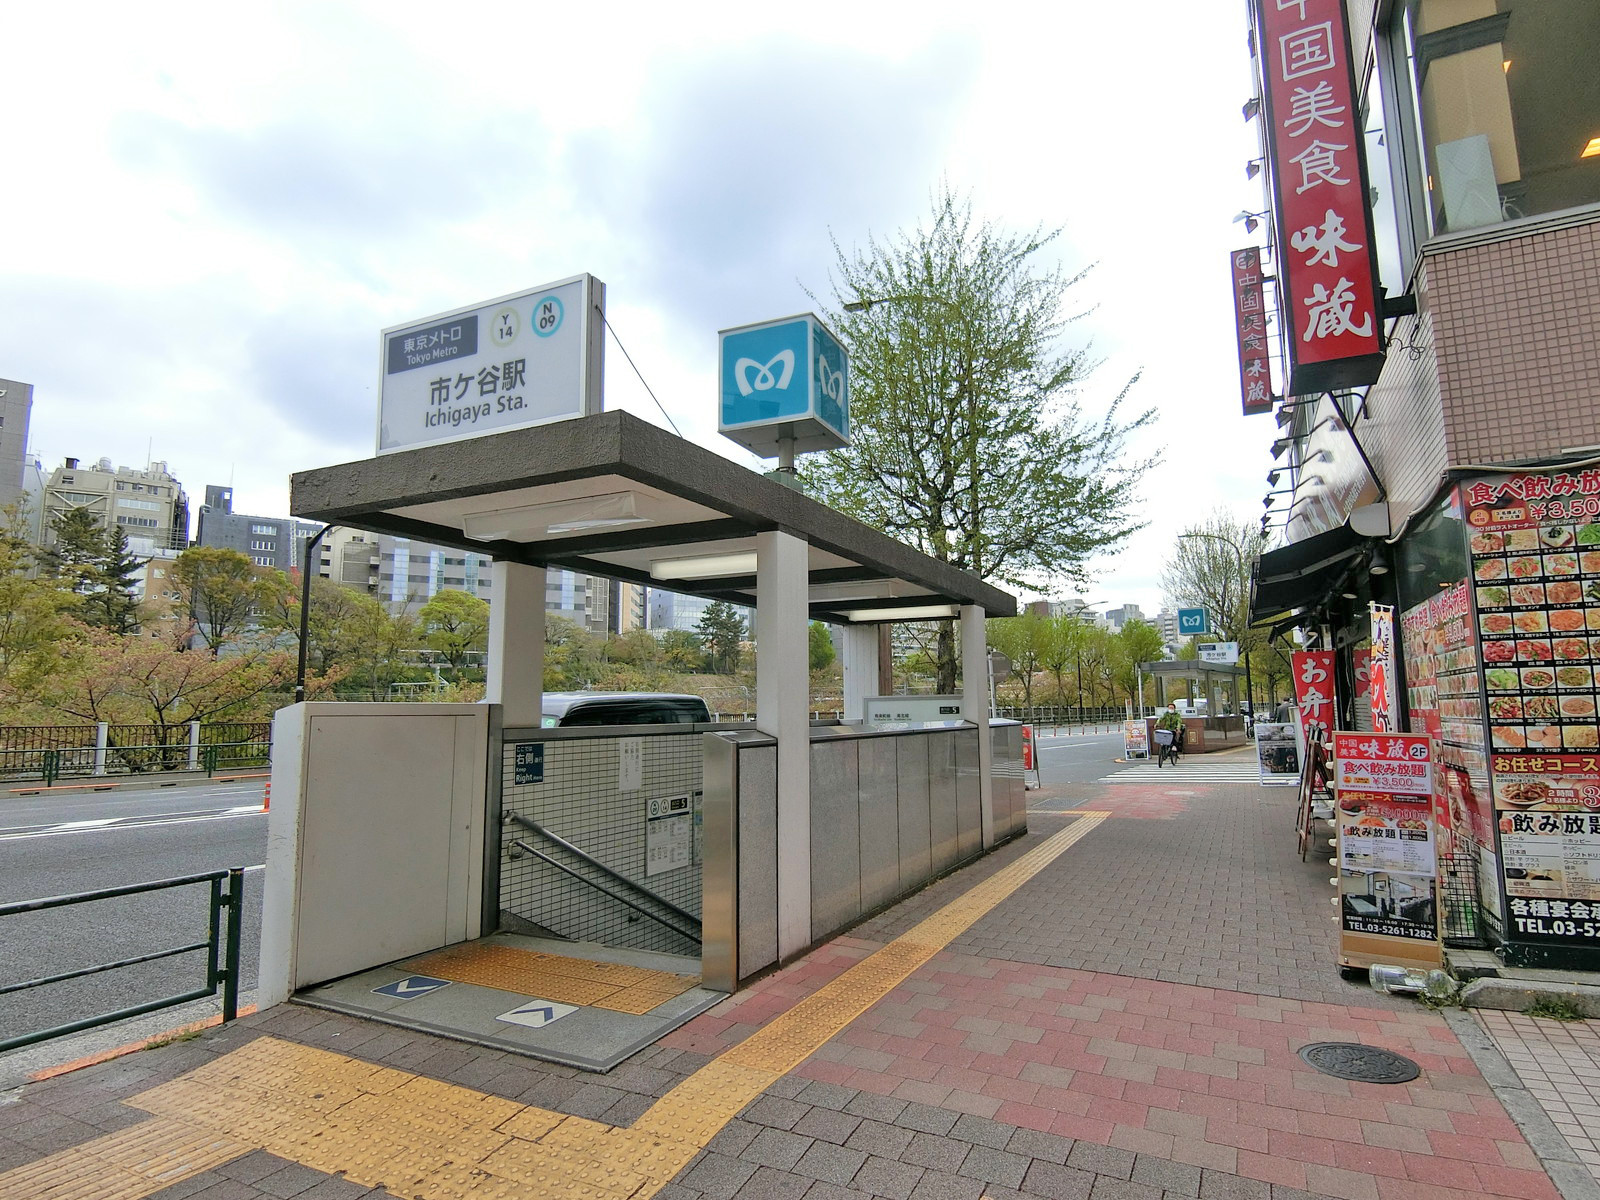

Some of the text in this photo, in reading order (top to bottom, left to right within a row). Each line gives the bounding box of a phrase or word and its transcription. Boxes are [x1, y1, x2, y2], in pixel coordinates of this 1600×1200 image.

[1290, 208, 1372, 343] 味蔵
[542, 302, 553, 315] N
[501, 314, 509, 325] Y
[539, 314, 556, 330] 09
[403, 325, 461, 354] 東京メトロ
[499, 326, 513, 340] 14
[406, 345, 458, 366] Tokyo Metro
[425, 395, 528, 428] Ichigaya Sta.
[1410, 746, 1426, 757] 2F
[1343, 761, 1426, 778] 食べ飲み放題
[1494, 757, 1599, 772] お任せコース
[516, 773, 533, 784] Right
